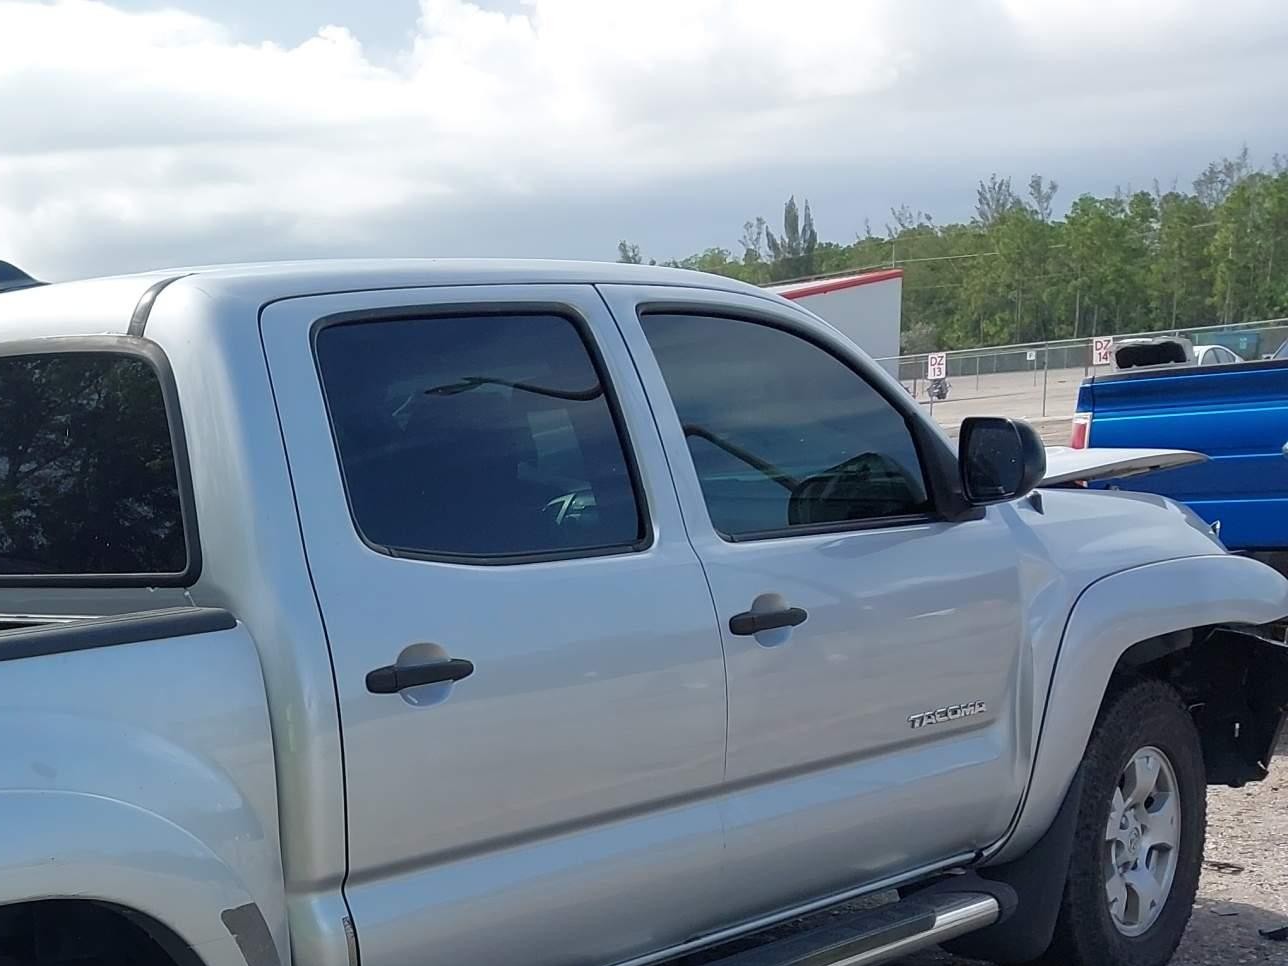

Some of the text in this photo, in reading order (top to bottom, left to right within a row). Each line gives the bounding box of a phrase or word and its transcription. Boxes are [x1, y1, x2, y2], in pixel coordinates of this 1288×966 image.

[930, 355, 944, 366] DZ
[933, 367, 942, 377] 13
[908, 700, 987, 729] TACOMA
